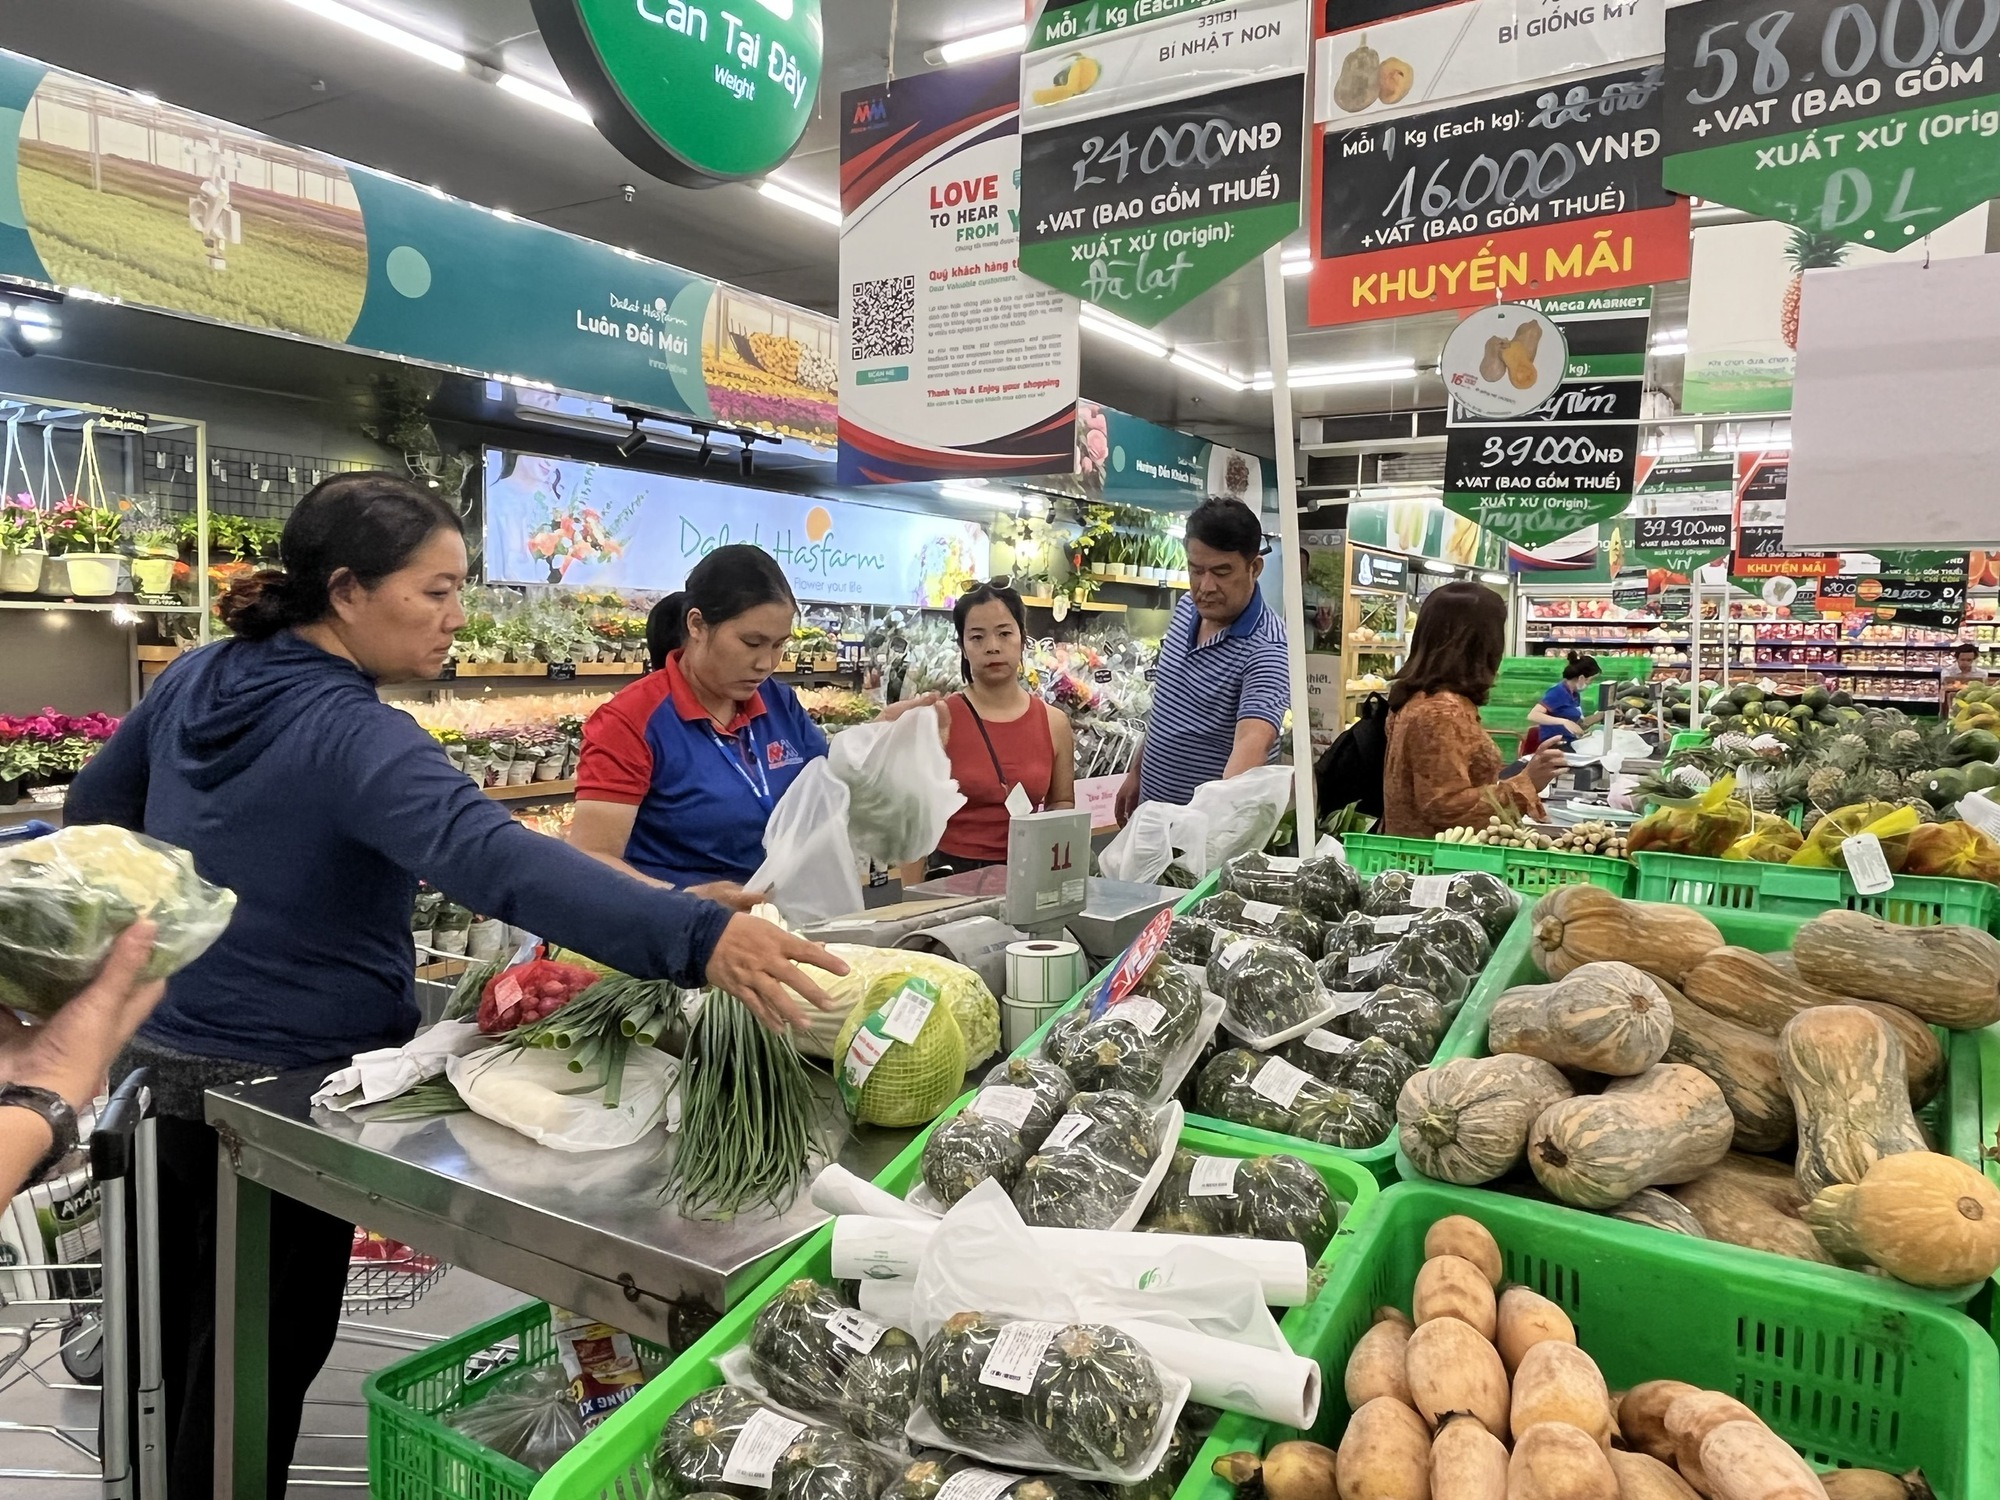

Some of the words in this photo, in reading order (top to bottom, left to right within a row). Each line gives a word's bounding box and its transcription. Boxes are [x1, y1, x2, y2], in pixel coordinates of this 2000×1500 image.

[721, 11, 760, 70] Tại
[1045, 14, 1077, 41] MỖI
[1077, 4, 1102, 38] 1
[1106, 9, 1127, 28] Kg
[1159, 41, 1176, 61] BÍ
[1181, 31, 1234, 55] NHẬT
[1241, 21, 1281, 44] NON
[1499, 22, 1519, 44] BÍ
[1526, 5, 1595, 37] GIỐNG
[714, 64, 756, 101] Weight
[1692, 98, 1778, 137] +VAT
[1791, 78, 1881, 123] (BAO
[1895, 51, 1983, 98] GỒM
[1216, 122, 1282, 156] VNĐ
[1342, 131, 1375, 158] MỖI
[1404, 130, 1426, 147] Kg
[1433, 111, 1485, 143] (Each
[1491, 109, 1525, 131] kg):
[1576, 128, 1661, 166] VNĐ
[1755, 128, 1845, 170] XUẤT
[1919, 109, 2000, 145] (Orig
[930, 174, 998, 210] LOVE
[1036, 207, 1085, 235] +VAT
[1092, 198, 1144, 230] (BAO
[1151, 181, 1200, 215] GỒM
[1208, 164, 1281, 206] THUẾ)
[930, 213, 950, 228] TO
[957, 204, 998, 225] HEAR
[956, 222, 999, 242] FROM
[1008, 209, 1020, 233] Y
[1361, 223, 1414, 248] +VAT
[1423, 213, 1478, 242] (BAO
[1486, 198, 1539, 228] GỒM
[1550, 181, 1626, 218] THUẾ)
[1071, 232, 1122, 261] XUẤT
[1163, 221, 1235, 252] (Origin):
[929, 268, 949, 281] Quý
[951, 261, 981, 279] khách
[984, 259, 1009, 274] hàng
[1352, 239, 1528, 308] KHUYẾN
[1545, 230, 1633, 283] MÃI
[609, 292, 640, 315] Dalat
[576, 309, 620, 338] Luôn
[625, 321, 654, 346] Đổi
[658, 331, 688, 356] Mới
[927, 389, 950, 397] Thank
[953, 387, 967, 395] You
[978, 384, 1000, 394] Enjoy
[1023, 378, 1060, 389] shopping
[1581, 448, 1624, 463] VNĐ
[1455, 476, 1491, 489] +VAT
[1495, 476, 1531, 490] (BAO
[1574, 471, 1621, 490] THUẾ)
[1642, 519, 1707, 537] 39.900
[773, 529, 884, 577] Hasfarm
[1747, 560, 1798, 574] KHUYẾN
[1802, 560, 1827, 573] MÃI
[794, 577, 824, 590] Flower
[827, 582, 847, 593] your
[1051, 841, 1072, 871] 11
